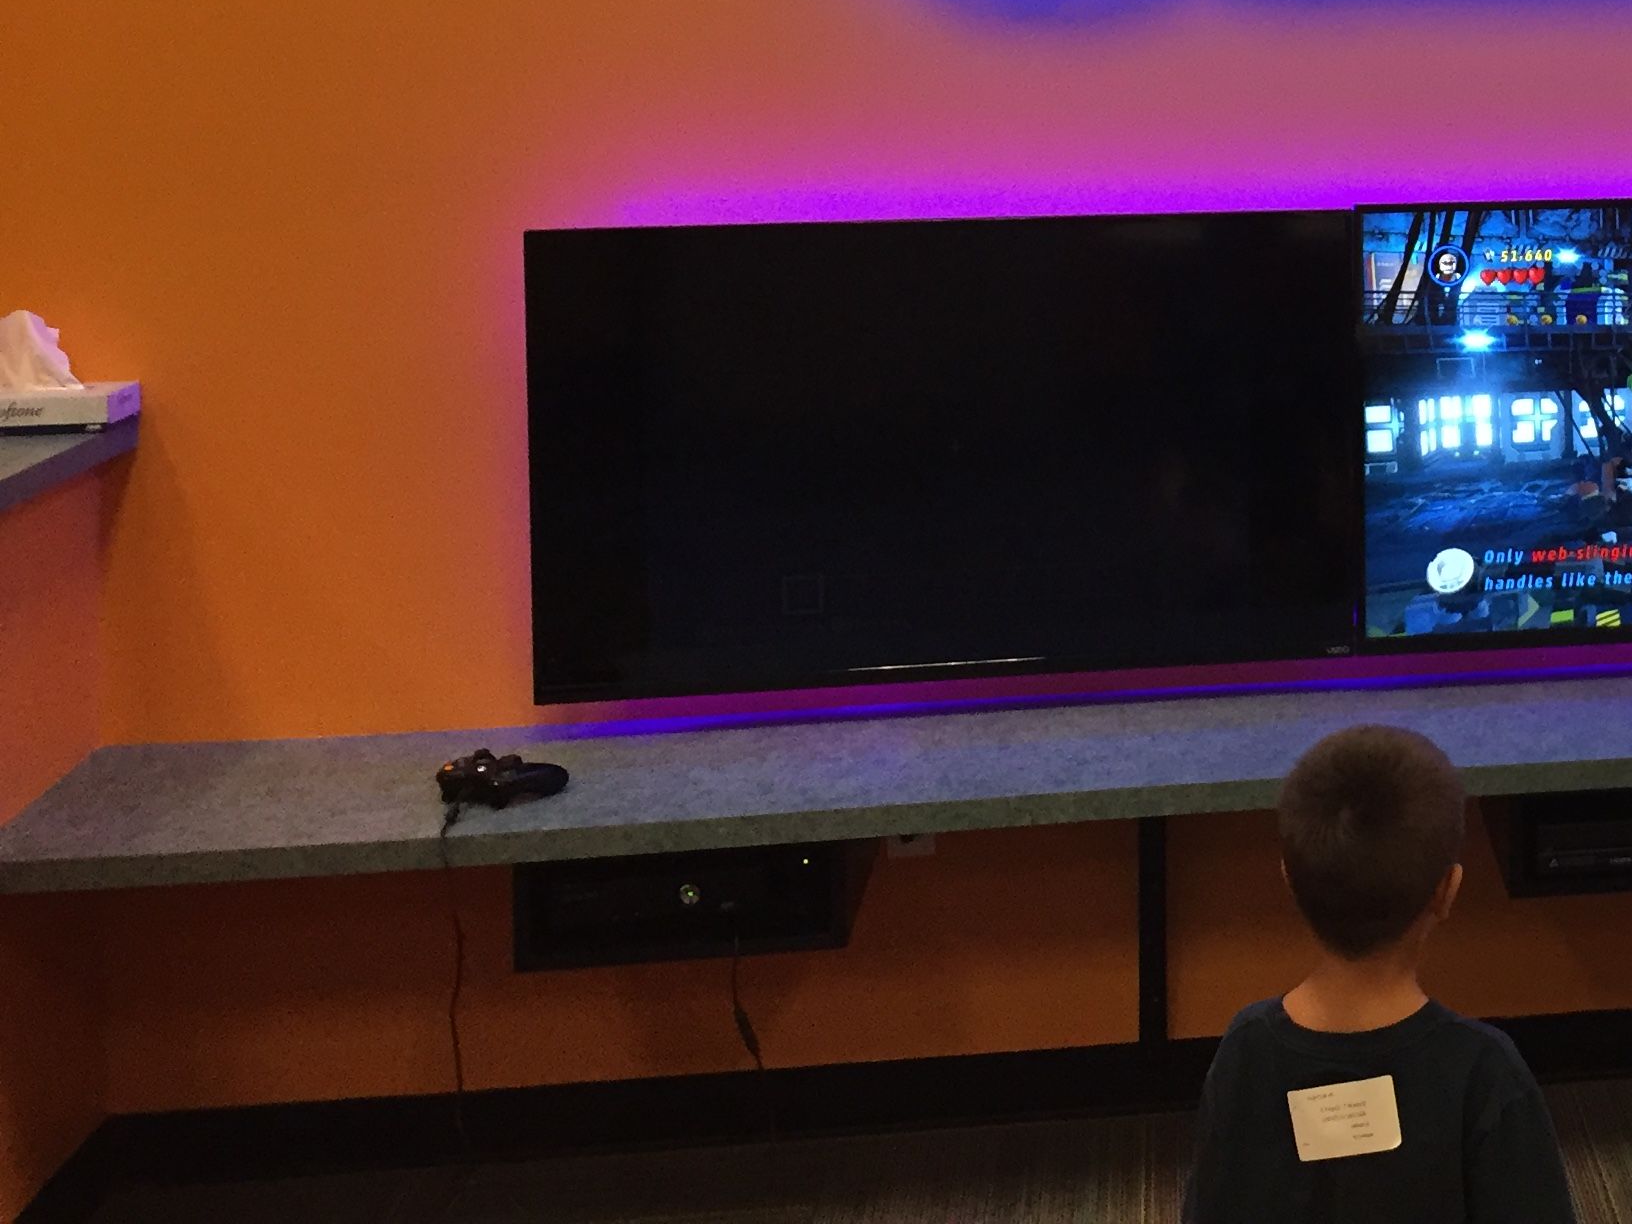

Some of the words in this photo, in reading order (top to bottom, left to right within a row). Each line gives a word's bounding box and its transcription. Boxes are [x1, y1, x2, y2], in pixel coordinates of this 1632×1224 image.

[1484, 548, 1523, 566] Only
[1484, 574, 1553, 591] handles
[1561, 571, 1597, 587] like
